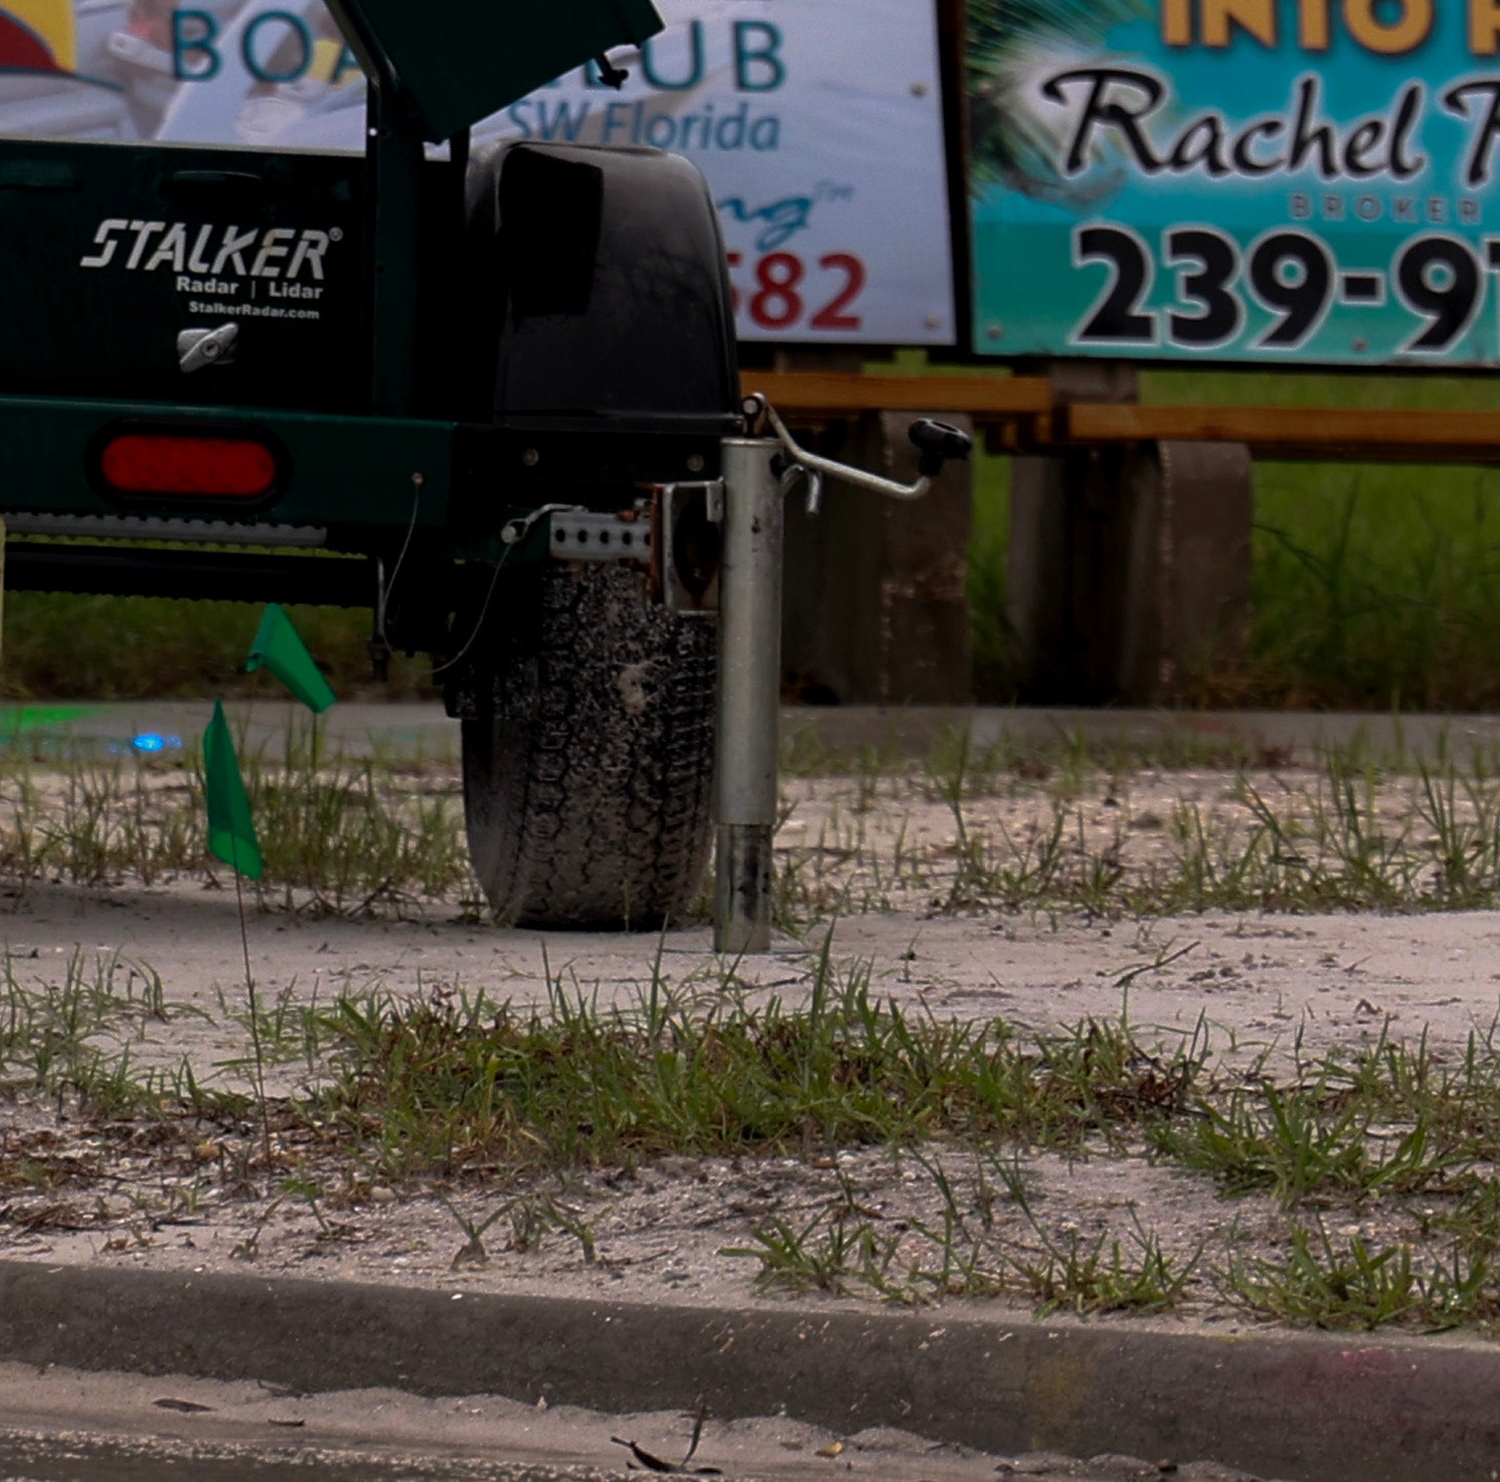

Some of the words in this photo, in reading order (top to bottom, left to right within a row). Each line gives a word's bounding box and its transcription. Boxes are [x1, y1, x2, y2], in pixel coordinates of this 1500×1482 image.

[508, 97, 592, 142] SW
[603, 101, 782, 152] Florida
[1040, 65, 1427, 180] Rachel
[1289, 192, 1482, 225] BROKER
[176, 275, 240, 296] Radar
[268, 281, 324, 300] Lidar
[1068, 221, 1500, 355] 239-9
[188, 300, 321, 321] StalkerRadar.com
